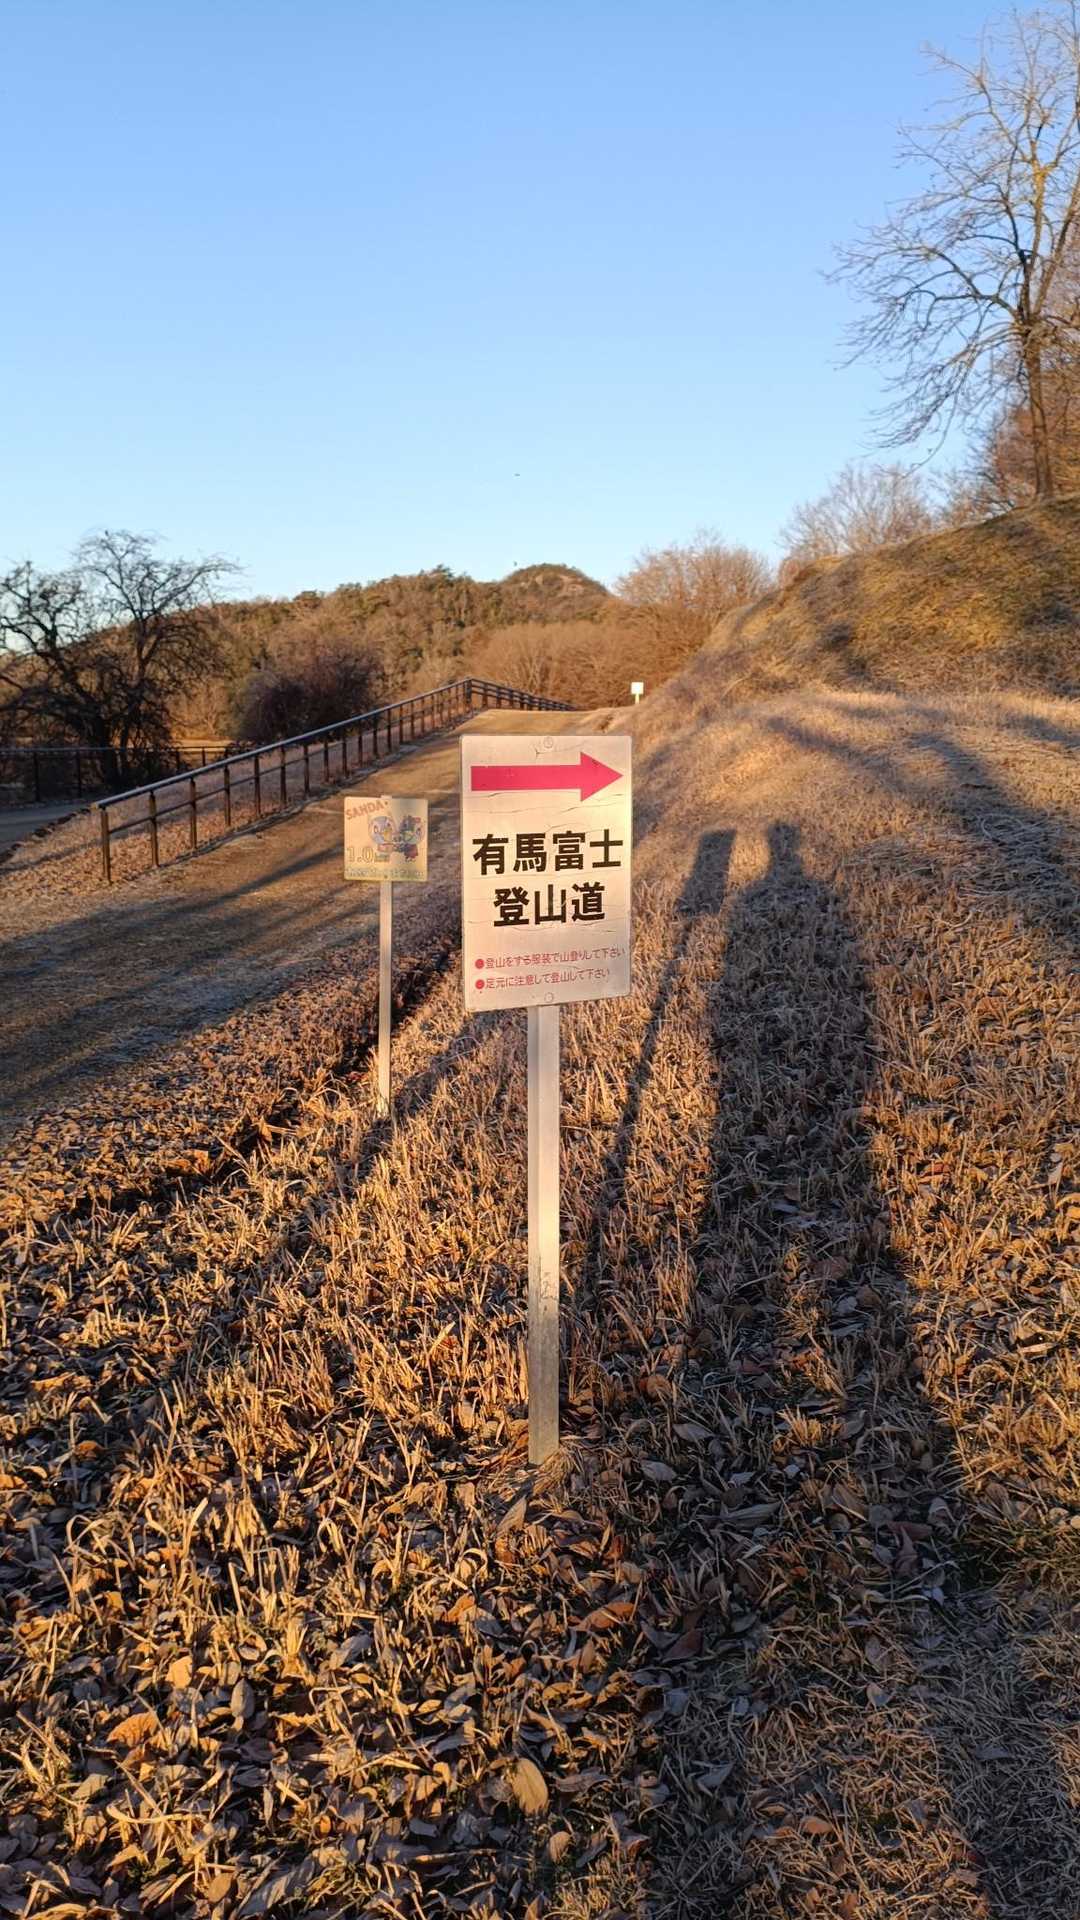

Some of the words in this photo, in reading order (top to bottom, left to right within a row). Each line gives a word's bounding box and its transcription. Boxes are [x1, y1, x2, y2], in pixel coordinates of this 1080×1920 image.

[472, 829, 623, 875] 有馬富士
[493, 882, 605, 927] 登山道
[486, 968, 610, 989] 足元に注意して登山して下さい
